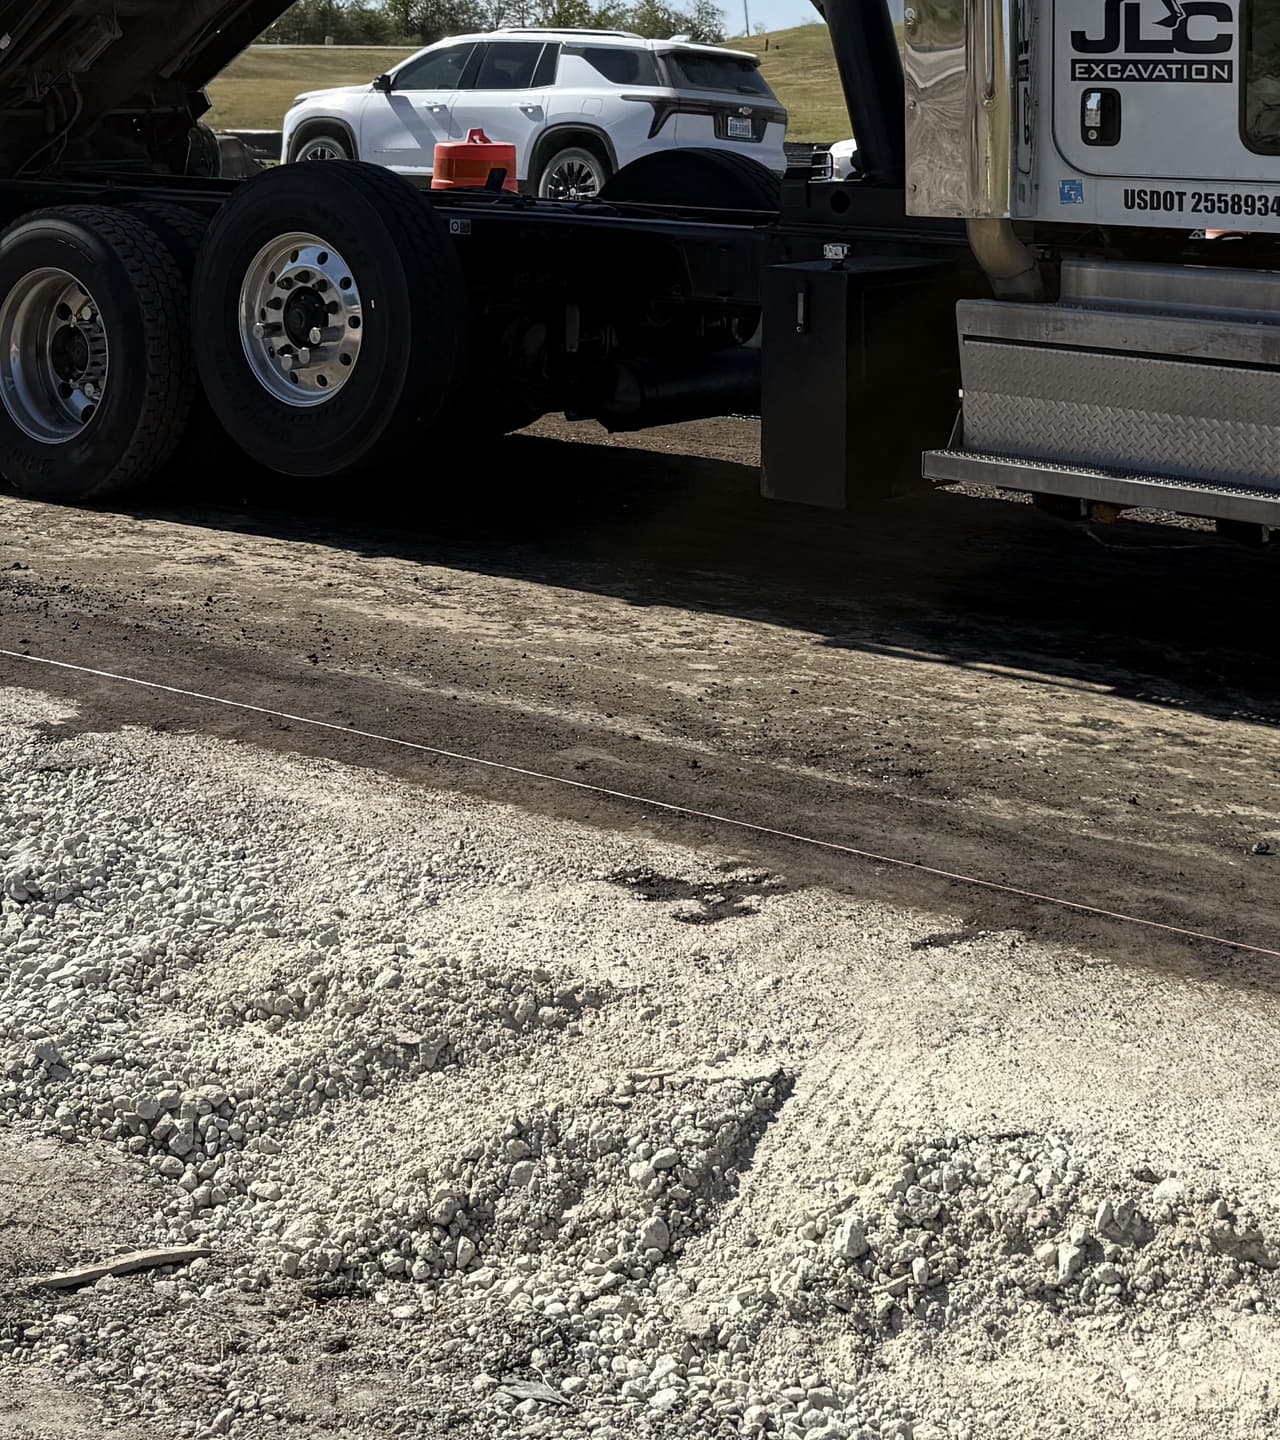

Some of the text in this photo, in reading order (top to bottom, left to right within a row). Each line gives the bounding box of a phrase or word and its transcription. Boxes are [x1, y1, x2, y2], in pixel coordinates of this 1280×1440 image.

[1071, 1, 1233, 54] JLC
[1074, 62, 1229, 80] EXCAVATION
[1124, 189, 1186, 212] USDOT
